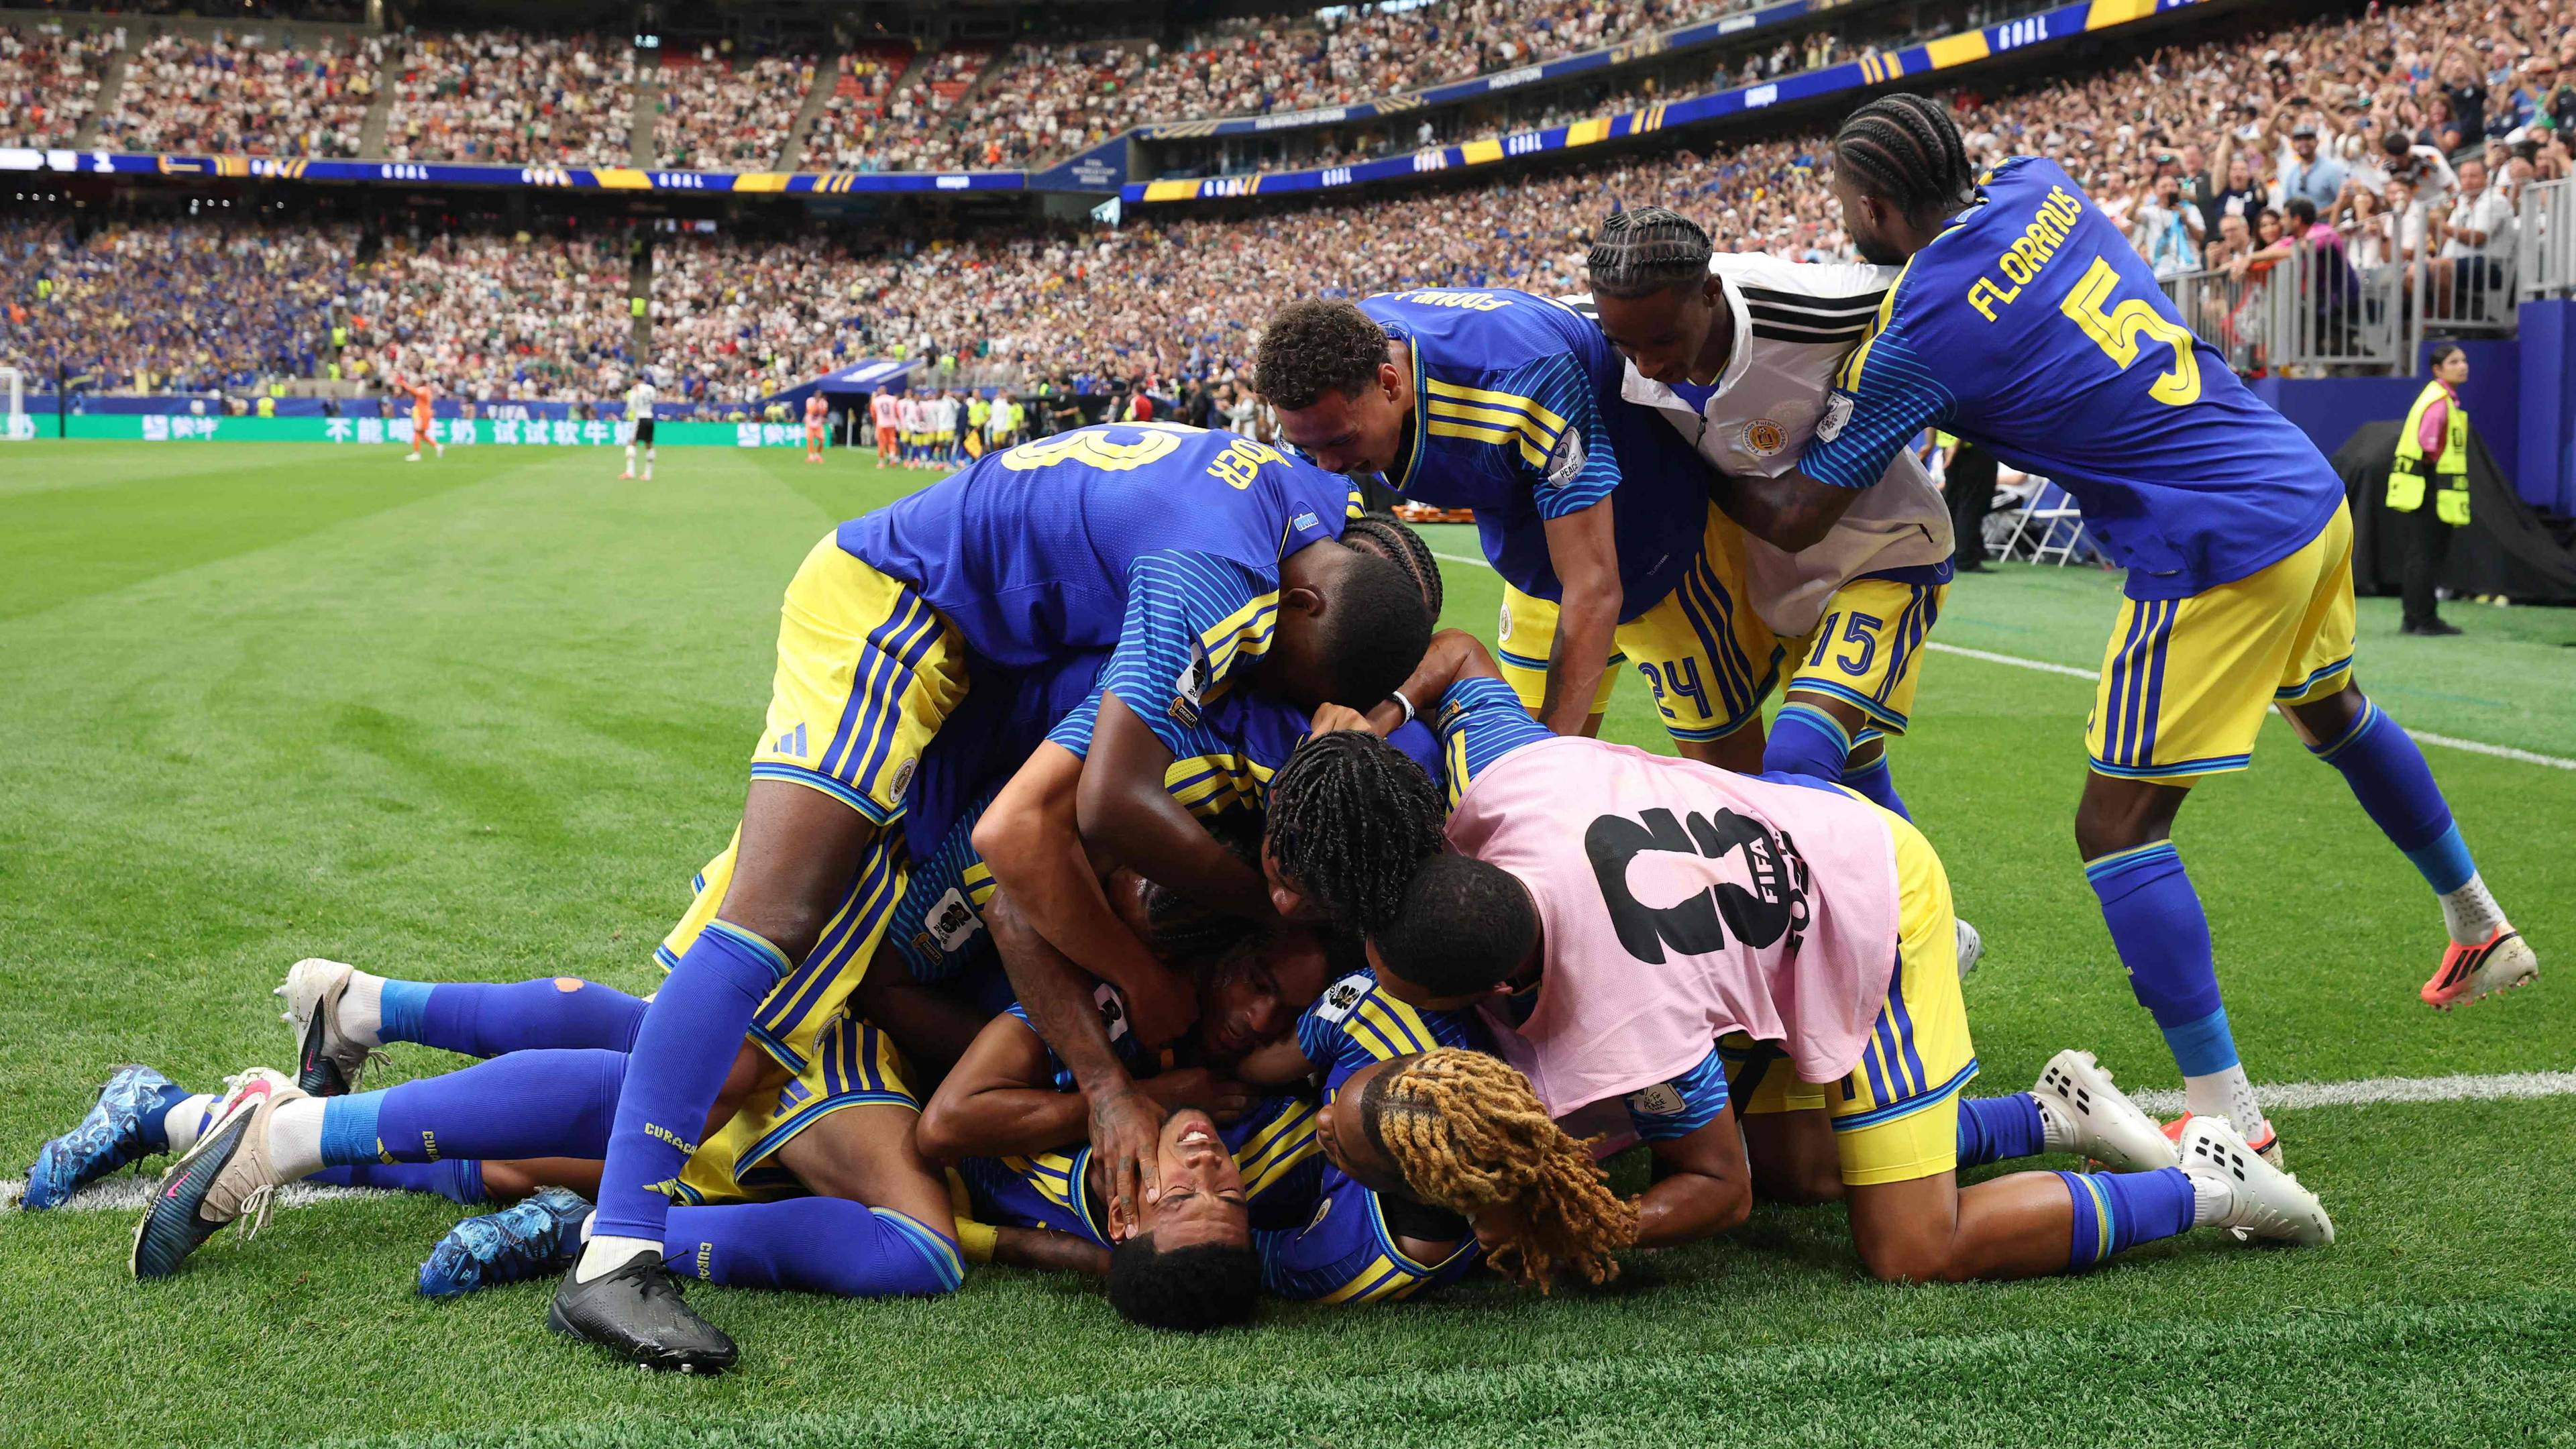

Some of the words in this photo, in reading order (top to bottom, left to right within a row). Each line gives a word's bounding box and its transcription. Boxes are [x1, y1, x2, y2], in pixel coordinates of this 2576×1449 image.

[1998, 15, 2048, 50] GOAL
[1508, 132, 1542, 156] GOAL
[380, 162, 429, 180] GOAL
[1322, 166, 1352, 187] GOAL
[1203, 178, 1244, 197] GOAL
[1967, 184, 2082, 323] FLORANUS
[2059, 255, 2202, 407] 5
[1560, 462, 1579, 478] PEACE
[1809, 611, 1884, 677] 15
[1638, 655, 1713, 720] 24
[1178, 708, 1195, 723] DEBUT
[1752, 837, 1778, 904] FIFA
